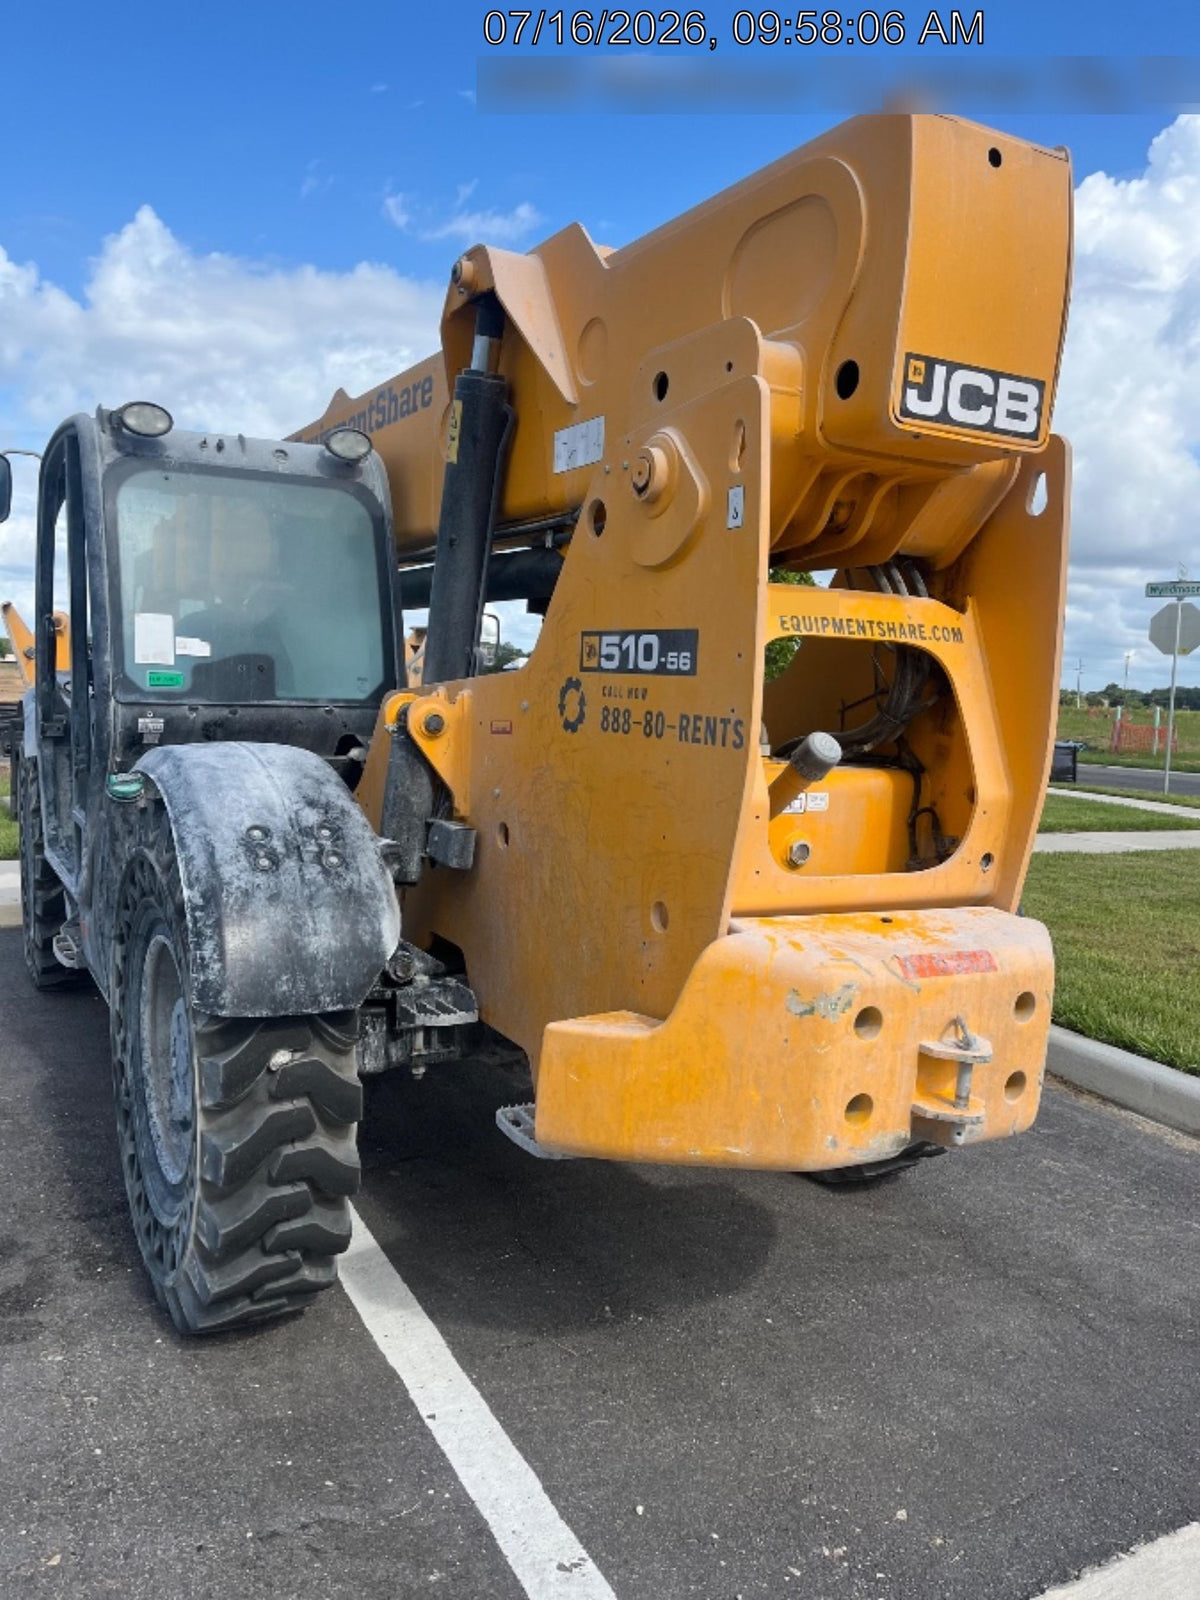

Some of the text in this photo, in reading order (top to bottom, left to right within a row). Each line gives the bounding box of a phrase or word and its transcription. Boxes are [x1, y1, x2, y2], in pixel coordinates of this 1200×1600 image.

[906, 364, 1039, 433] JCB
[779, 615, 965, 644] EQUIPMENTSHARE.COM
[602, 685, 623, 699] CALL
[600, 705, 745, 750] 888-80-RENTS
